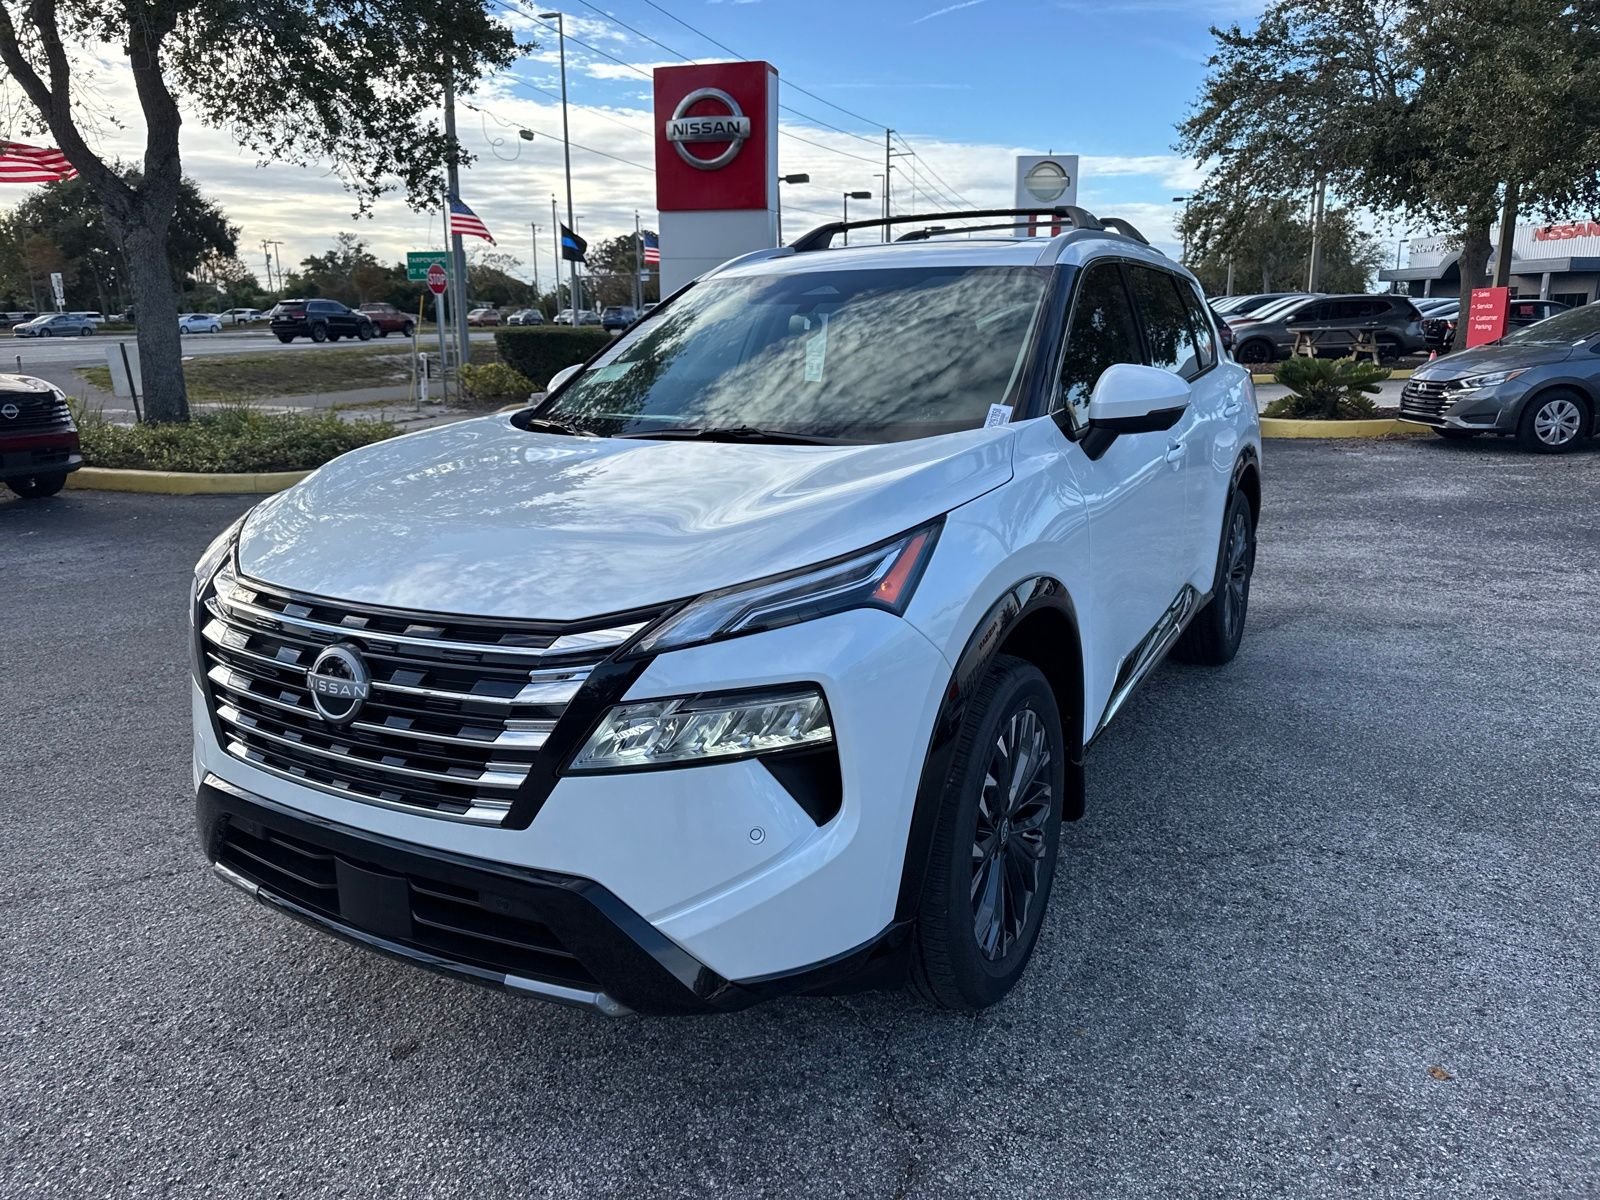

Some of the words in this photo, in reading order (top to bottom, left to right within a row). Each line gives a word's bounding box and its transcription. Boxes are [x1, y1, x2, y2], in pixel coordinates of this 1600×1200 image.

[673, 121, 740, 136] NISSAN
[1534, 222, 1600, 241] NISSAN
[429, 273, 446, 285] STOP
[307, 674, 367, 697] NISSAN
